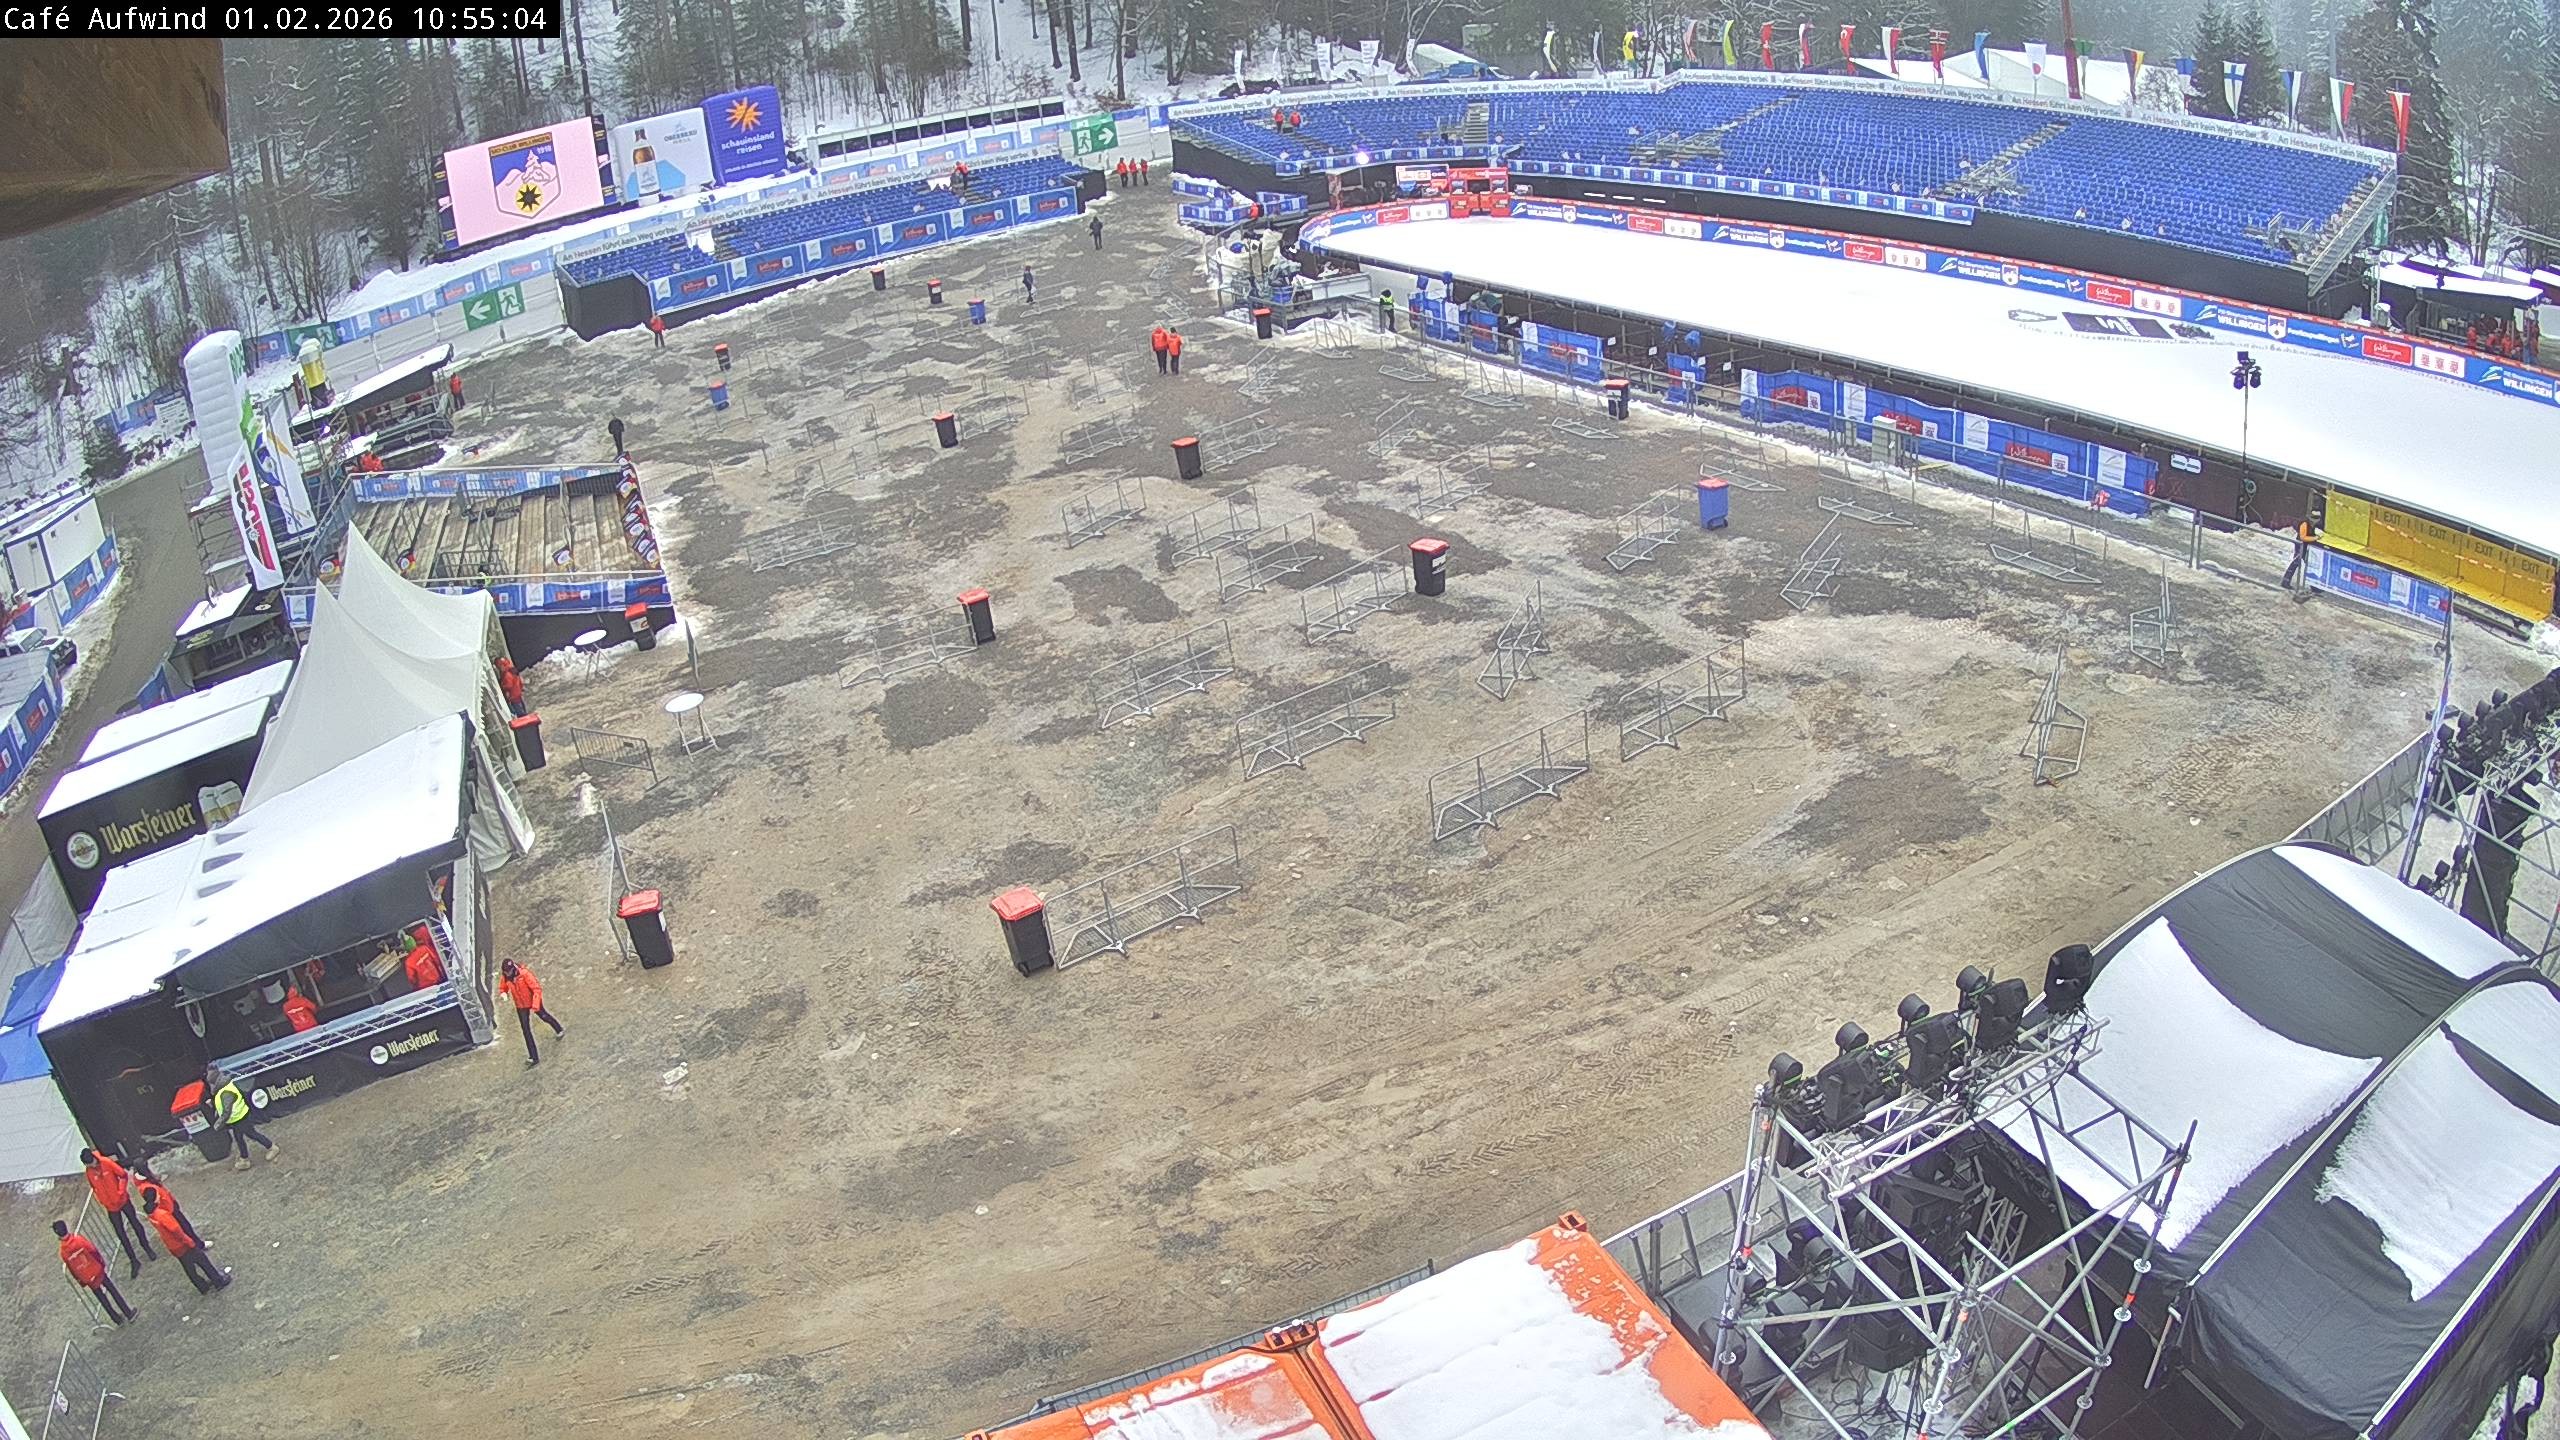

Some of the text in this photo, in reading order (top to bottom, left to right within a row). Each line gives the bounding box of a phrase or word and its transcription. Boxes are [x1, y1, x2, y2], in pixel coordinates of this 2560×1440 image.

[2141, 114, 2151, 122] An
[2152, 115, 2180, 126] Hessen
[2278, 134, 2289, 144] An
[2290, 136, 2318, 150] Hessen
[563, 254, 574, 262] An
[574, 247, 602, 259] Hessen
[637, 232, 654, 242] Weg
[98, 802, 196, 855] Warsteiner
[386, 1029, 440, 1058] Warsteiner
[266, 1075, 317, 1101] Warsteiner
